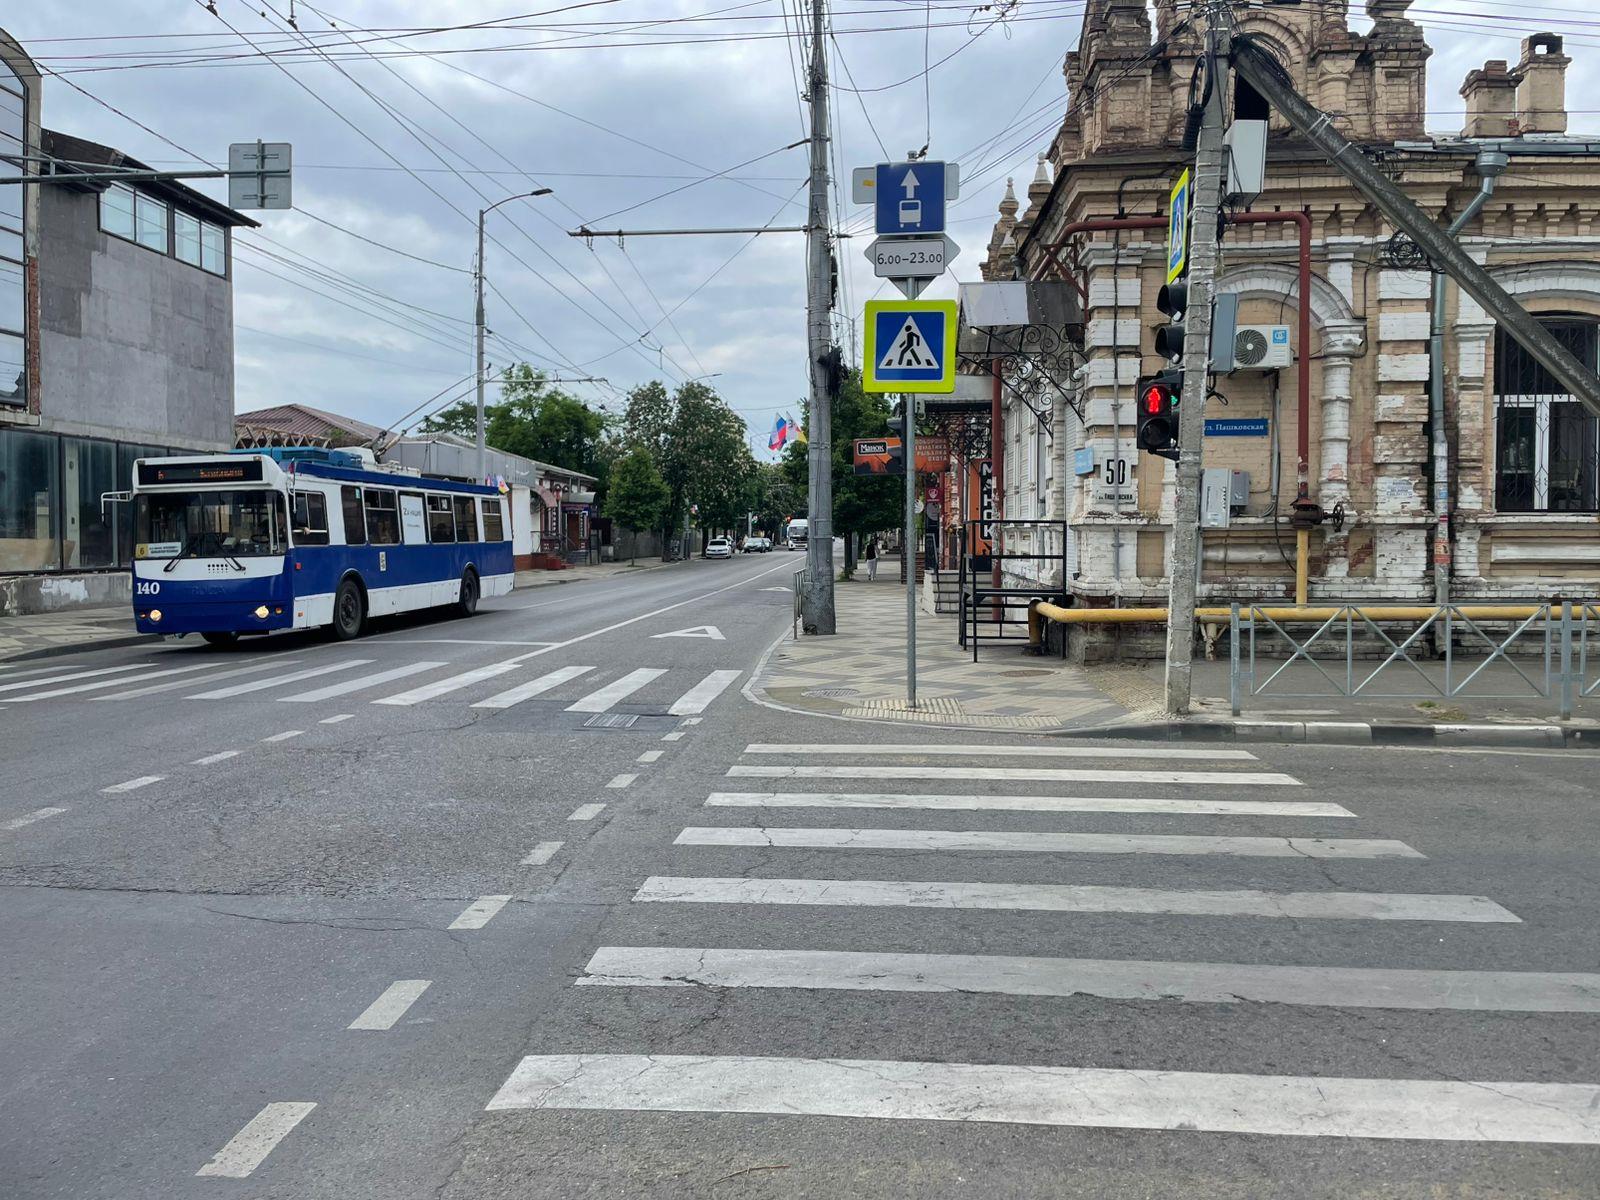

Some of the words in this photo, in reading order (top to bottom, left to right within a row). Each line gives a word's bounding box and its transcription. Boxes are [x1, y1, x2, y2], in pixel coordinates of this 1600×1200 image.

[877, 252, 943, 265] 6.00-23.00
[1215, 423, 1264, 431] Пашковская
[1106, 459, 1126, 485] 50
[136, 582, 160, 595] 140
